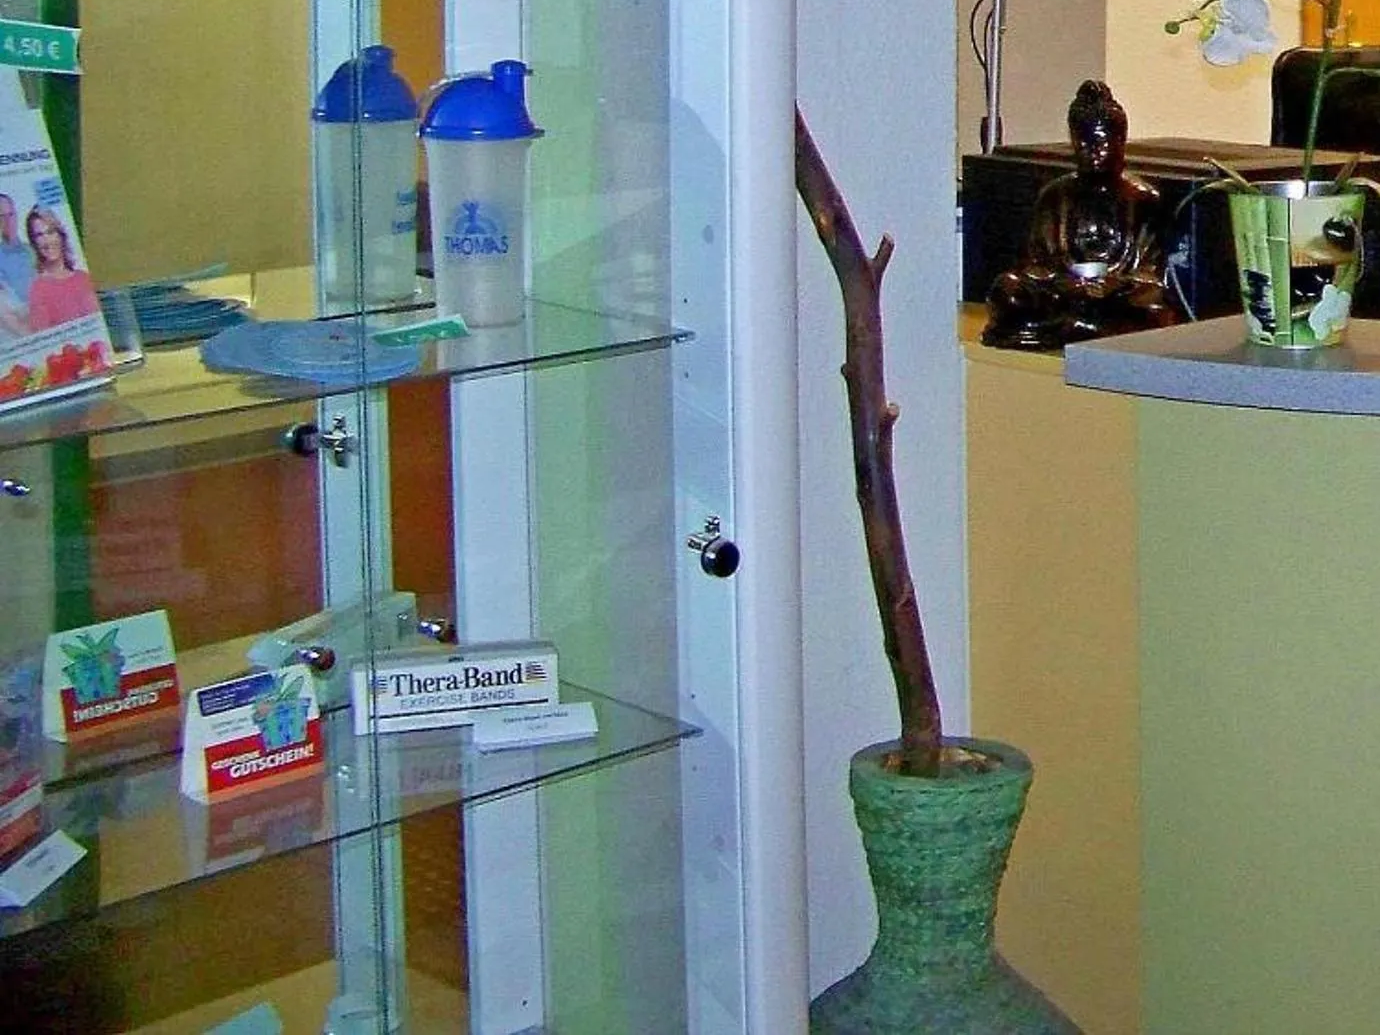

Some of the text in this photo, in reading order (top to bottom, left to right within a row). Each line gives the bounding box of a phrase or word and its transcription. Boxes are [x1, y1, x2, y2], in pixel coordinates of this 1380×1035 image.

[444, 235, 509, 255] THOMAS
[389, 662, 524, 698] Thera-Band
[400, 688, 516, 709] EXERCISE BANDS
[229, 743, 315, 779] GUTSCHEIN!
